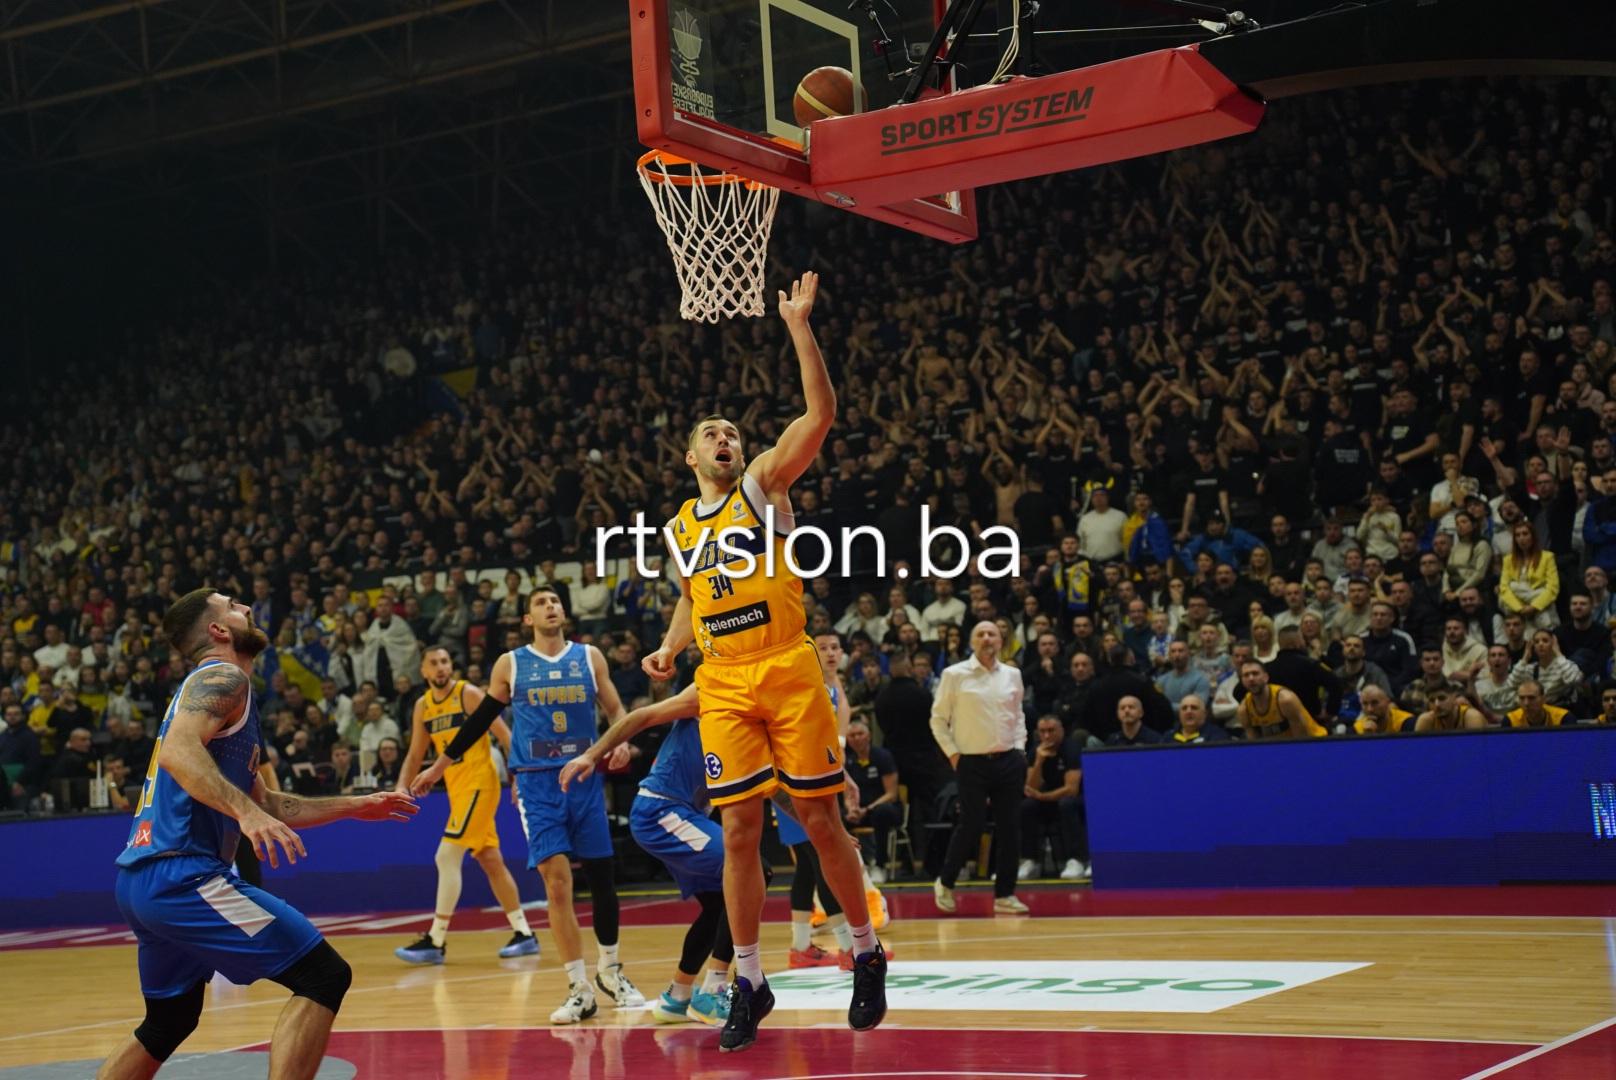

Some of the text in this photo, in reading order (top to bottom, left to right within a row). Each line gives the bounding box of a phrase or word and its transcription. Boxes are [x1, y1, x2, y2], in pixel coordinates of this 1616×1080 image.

[881, 86, 1095, 147] SPORT SYSTEM
[708, 574, 735, 600] 34
[705, 608, 764, 633] telemach
[527, 684, 587, 706] CYPRUS
[552, 710, 567, 734] 9
